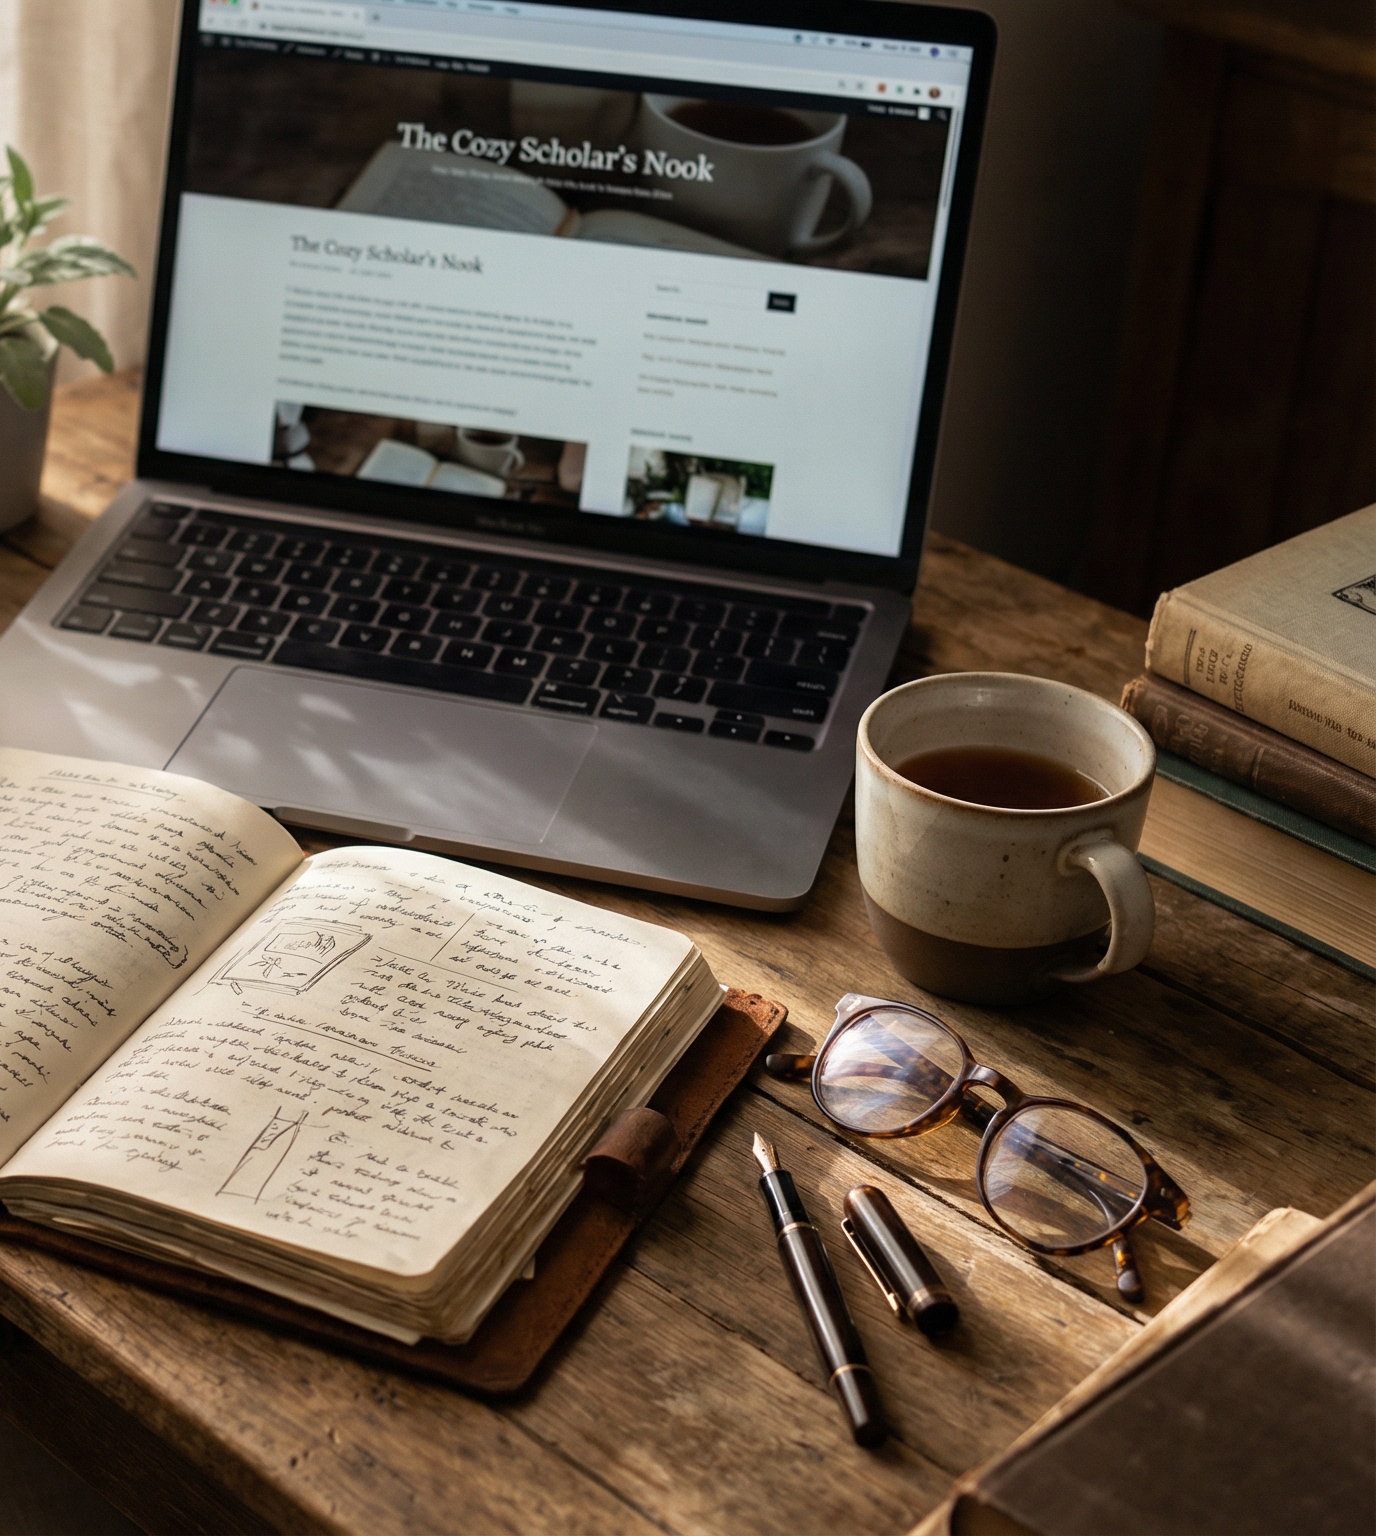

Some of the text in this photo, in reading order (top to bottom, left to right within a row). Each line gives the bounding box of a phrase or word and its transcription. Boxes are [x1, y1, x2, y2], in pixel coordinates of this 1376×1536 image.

[397, 122, 447, 152] The
[451, 129, 516, 166] Cozy
[519, 136, 638, 174] Scholar's
[642, 150, 715, 182] Nook
[291, 236, 483, 274] The Cozy Scholar's Nook
